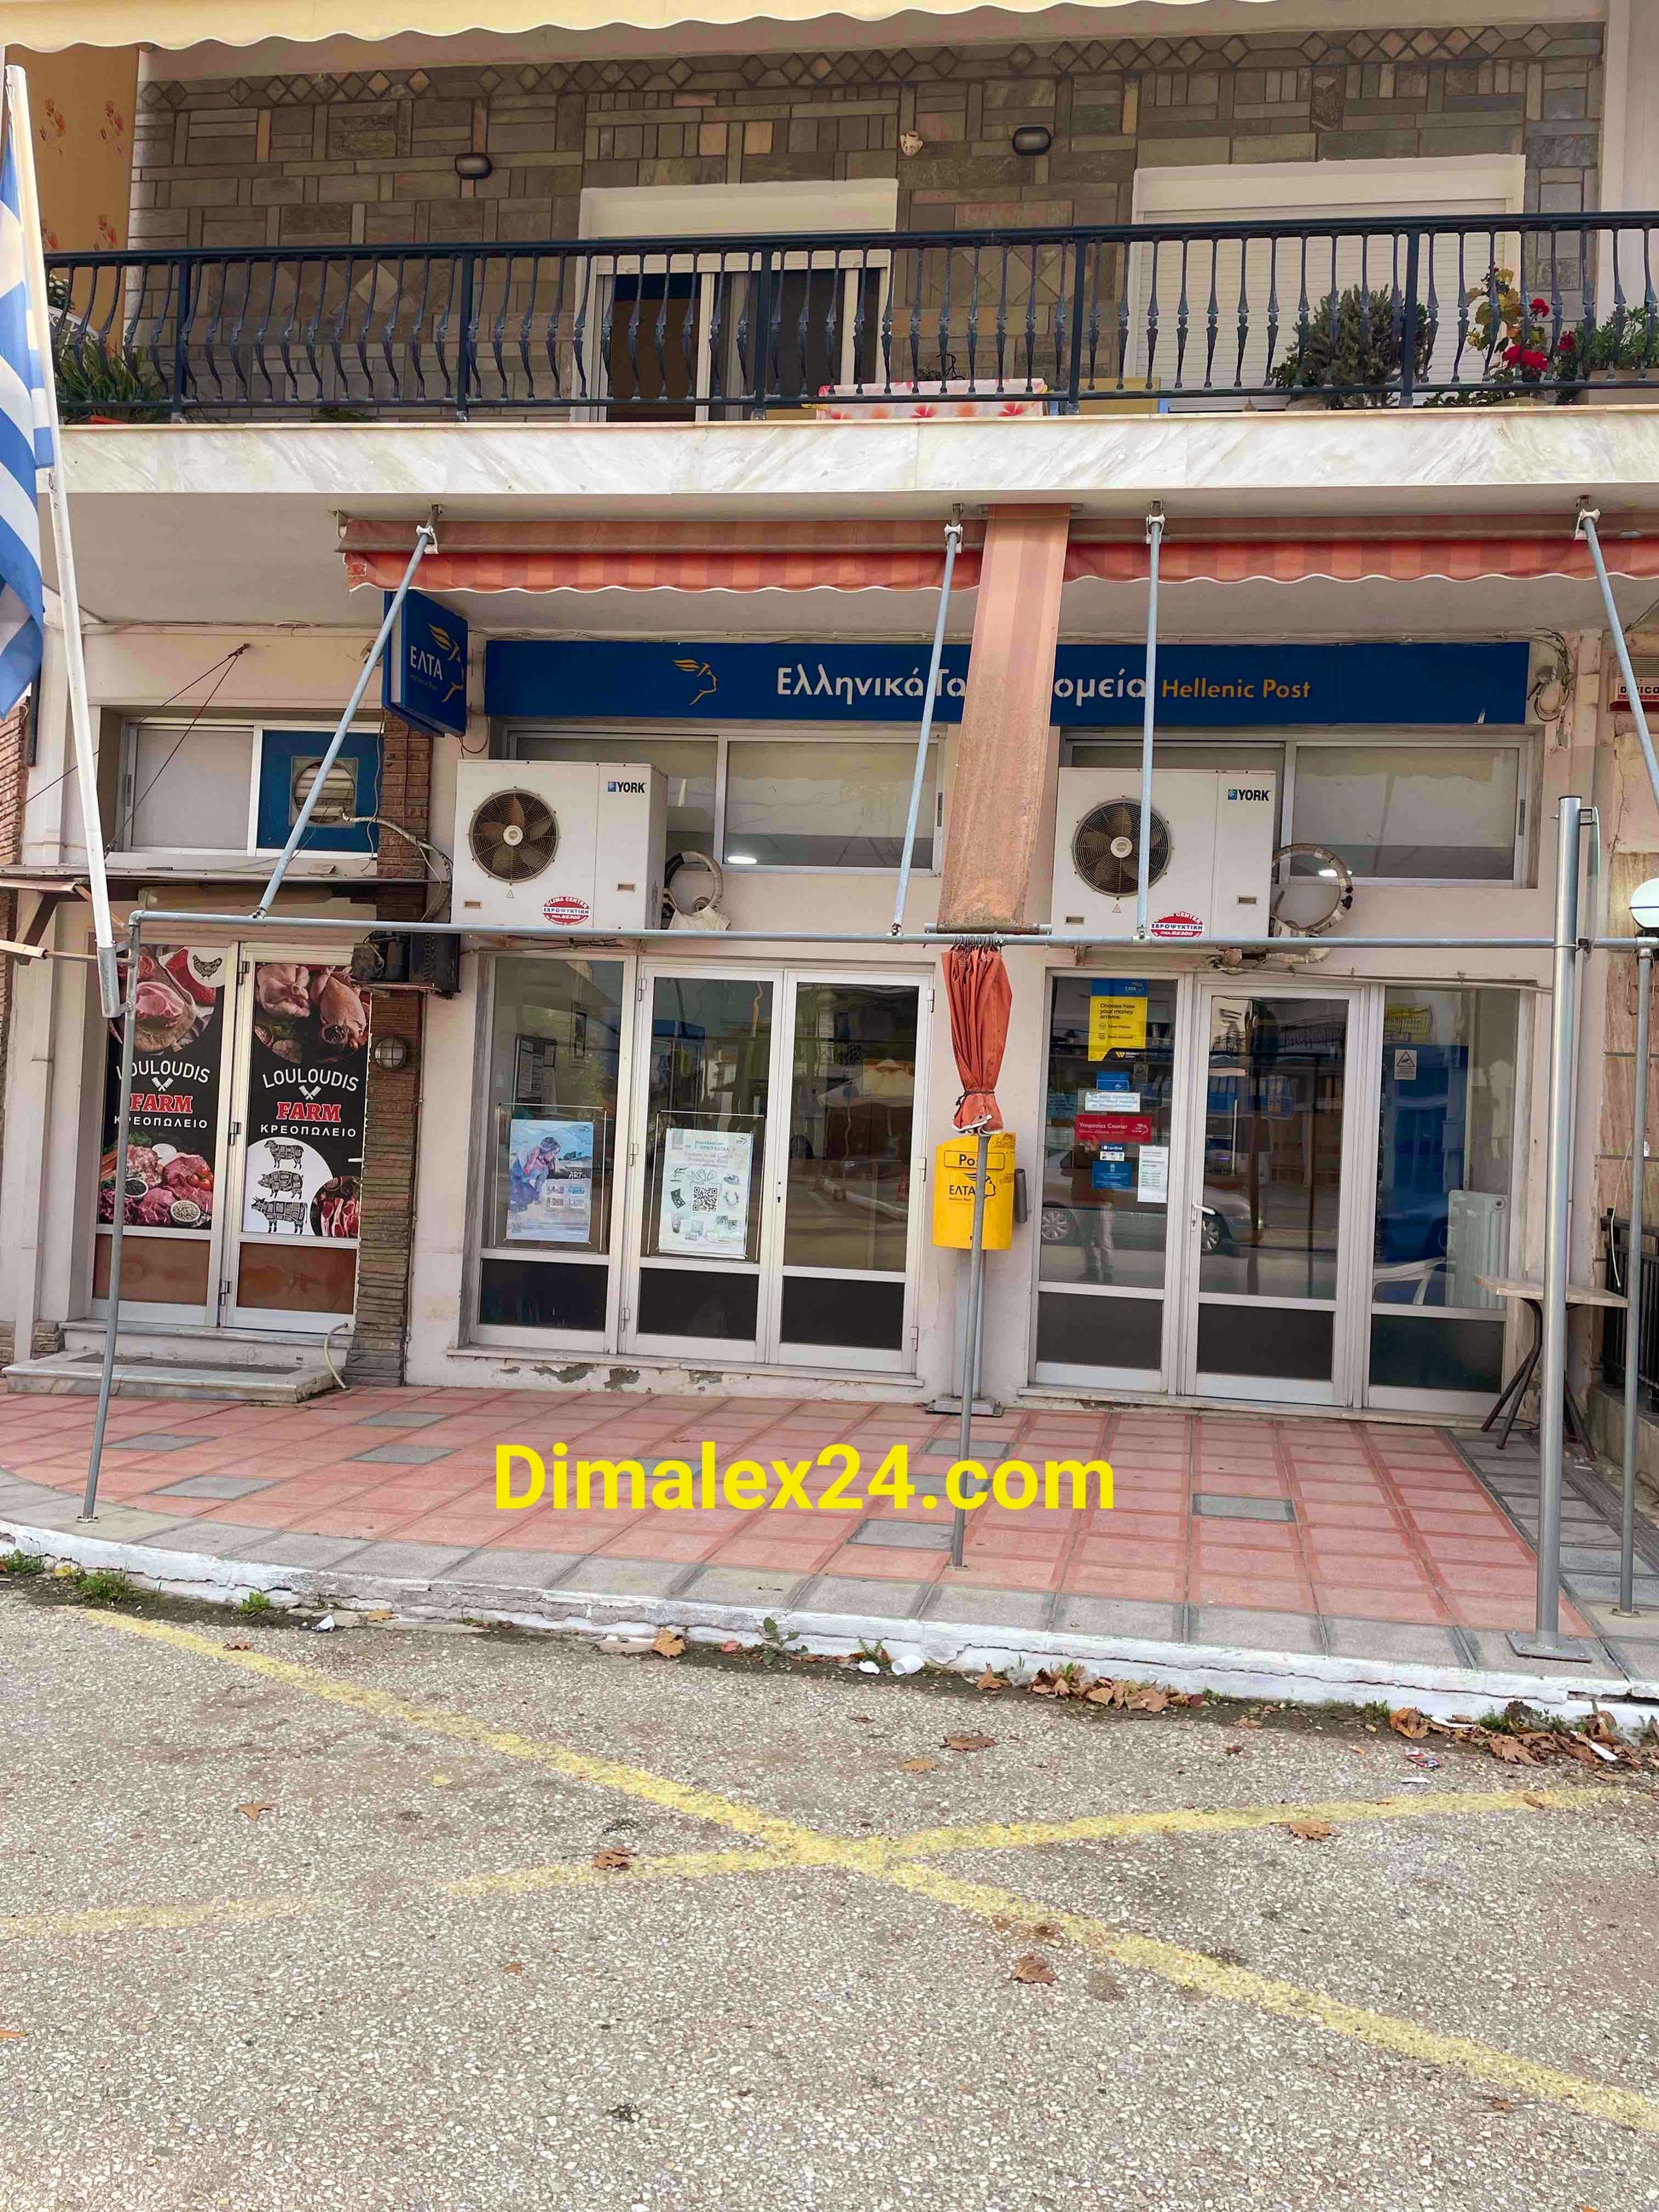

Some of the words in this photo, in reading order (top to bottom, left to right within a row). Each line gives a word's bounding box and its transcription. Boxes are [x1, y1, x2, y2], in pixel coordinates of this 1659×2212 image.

[410, 645, 442, 681] ΕΛΤΑ
[777, 663, 924, 705] Ελληνικά
[935, 668, 1146, 707] Ταομεία
[1162, 678, 1254, 698] Hellenic
[1263, 679, 1310, 698] Post
[617, 783, 645, 793] YORK
[1239, 789, 1269, 801] YORK
[262, 1068, 359, 1092] LOULOUDIS
[130, 1093, 194, 1113] FARM
[276, 1101, 342, 1123] FARM
[114, 1116, 207, 1129] ΚΕΟΠΩΛΕΙΟ
[260, 1124, 356, 1137] ΚΡΕΟΠΩΛΕΙΟ
[949, 1185, 976, 1195] ΕΛΤΑ
